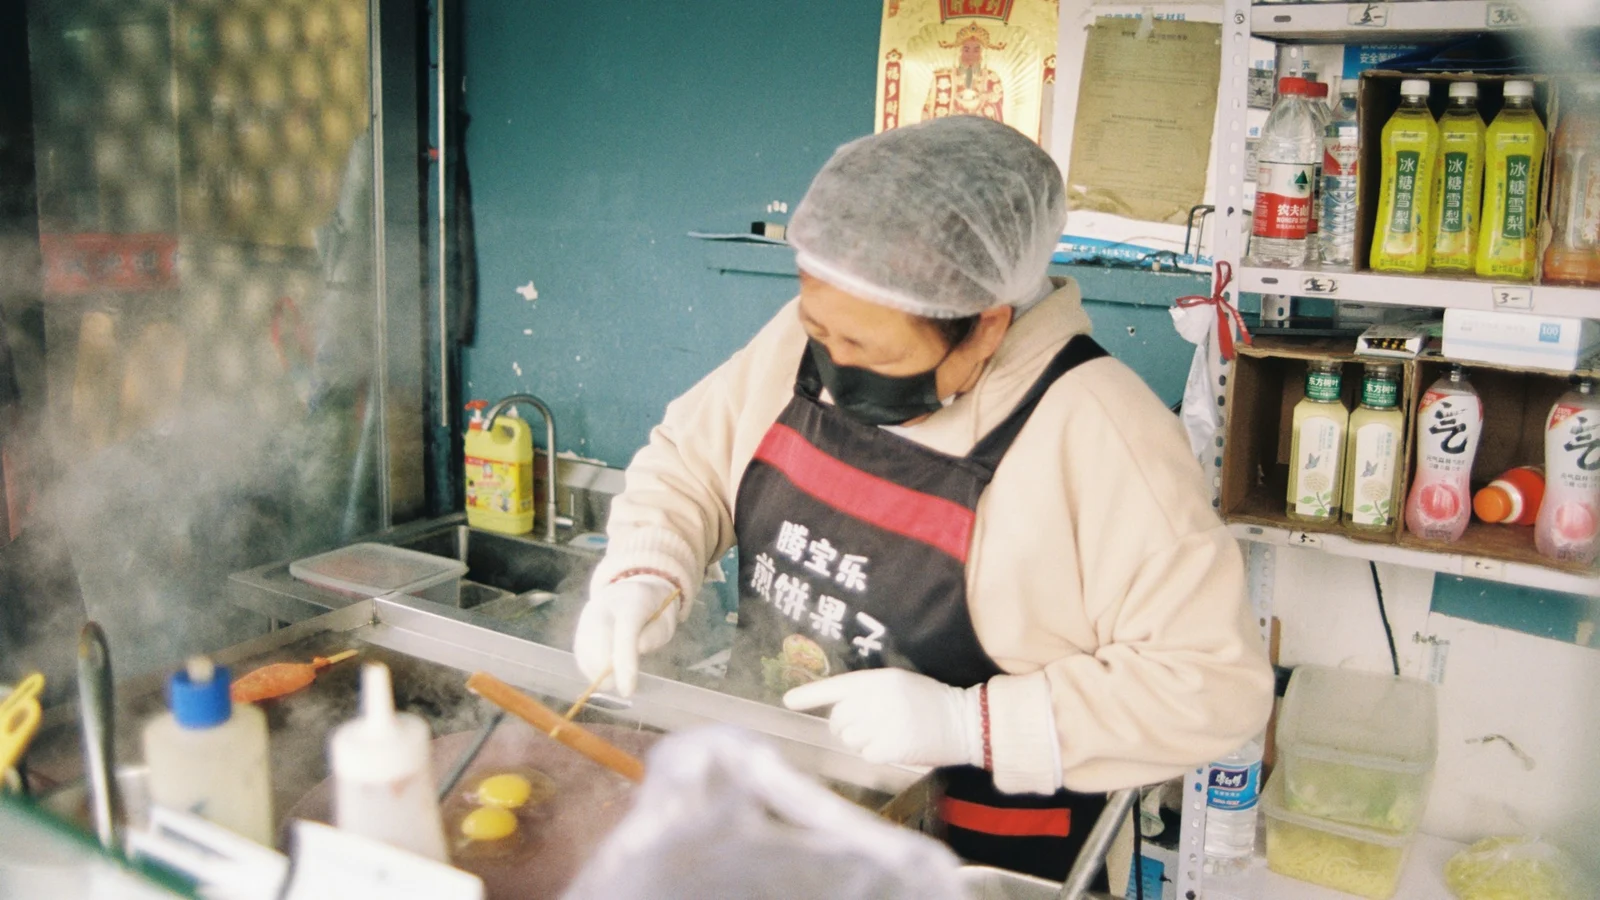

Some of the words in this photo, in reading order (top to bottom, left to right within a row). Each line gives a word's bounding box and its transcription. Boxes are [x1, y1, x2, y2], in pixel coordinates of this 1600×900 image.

[1394, 157, 1415, 225] 冰糖雪梨
[1445, 158, 1463, 225] 冰糖雪梨
[1507, 162, 1526, 231] 冰糖雪梨
[1541, 326, 1559, 337] 100
[1308, 376, 1338, 388] 东方树叶
[1365, 383, 1396, 395] 东方树叶
[776, 520, 869, 592] 腾宝乐
[750, 552, 886, 657] 煎饼果子
